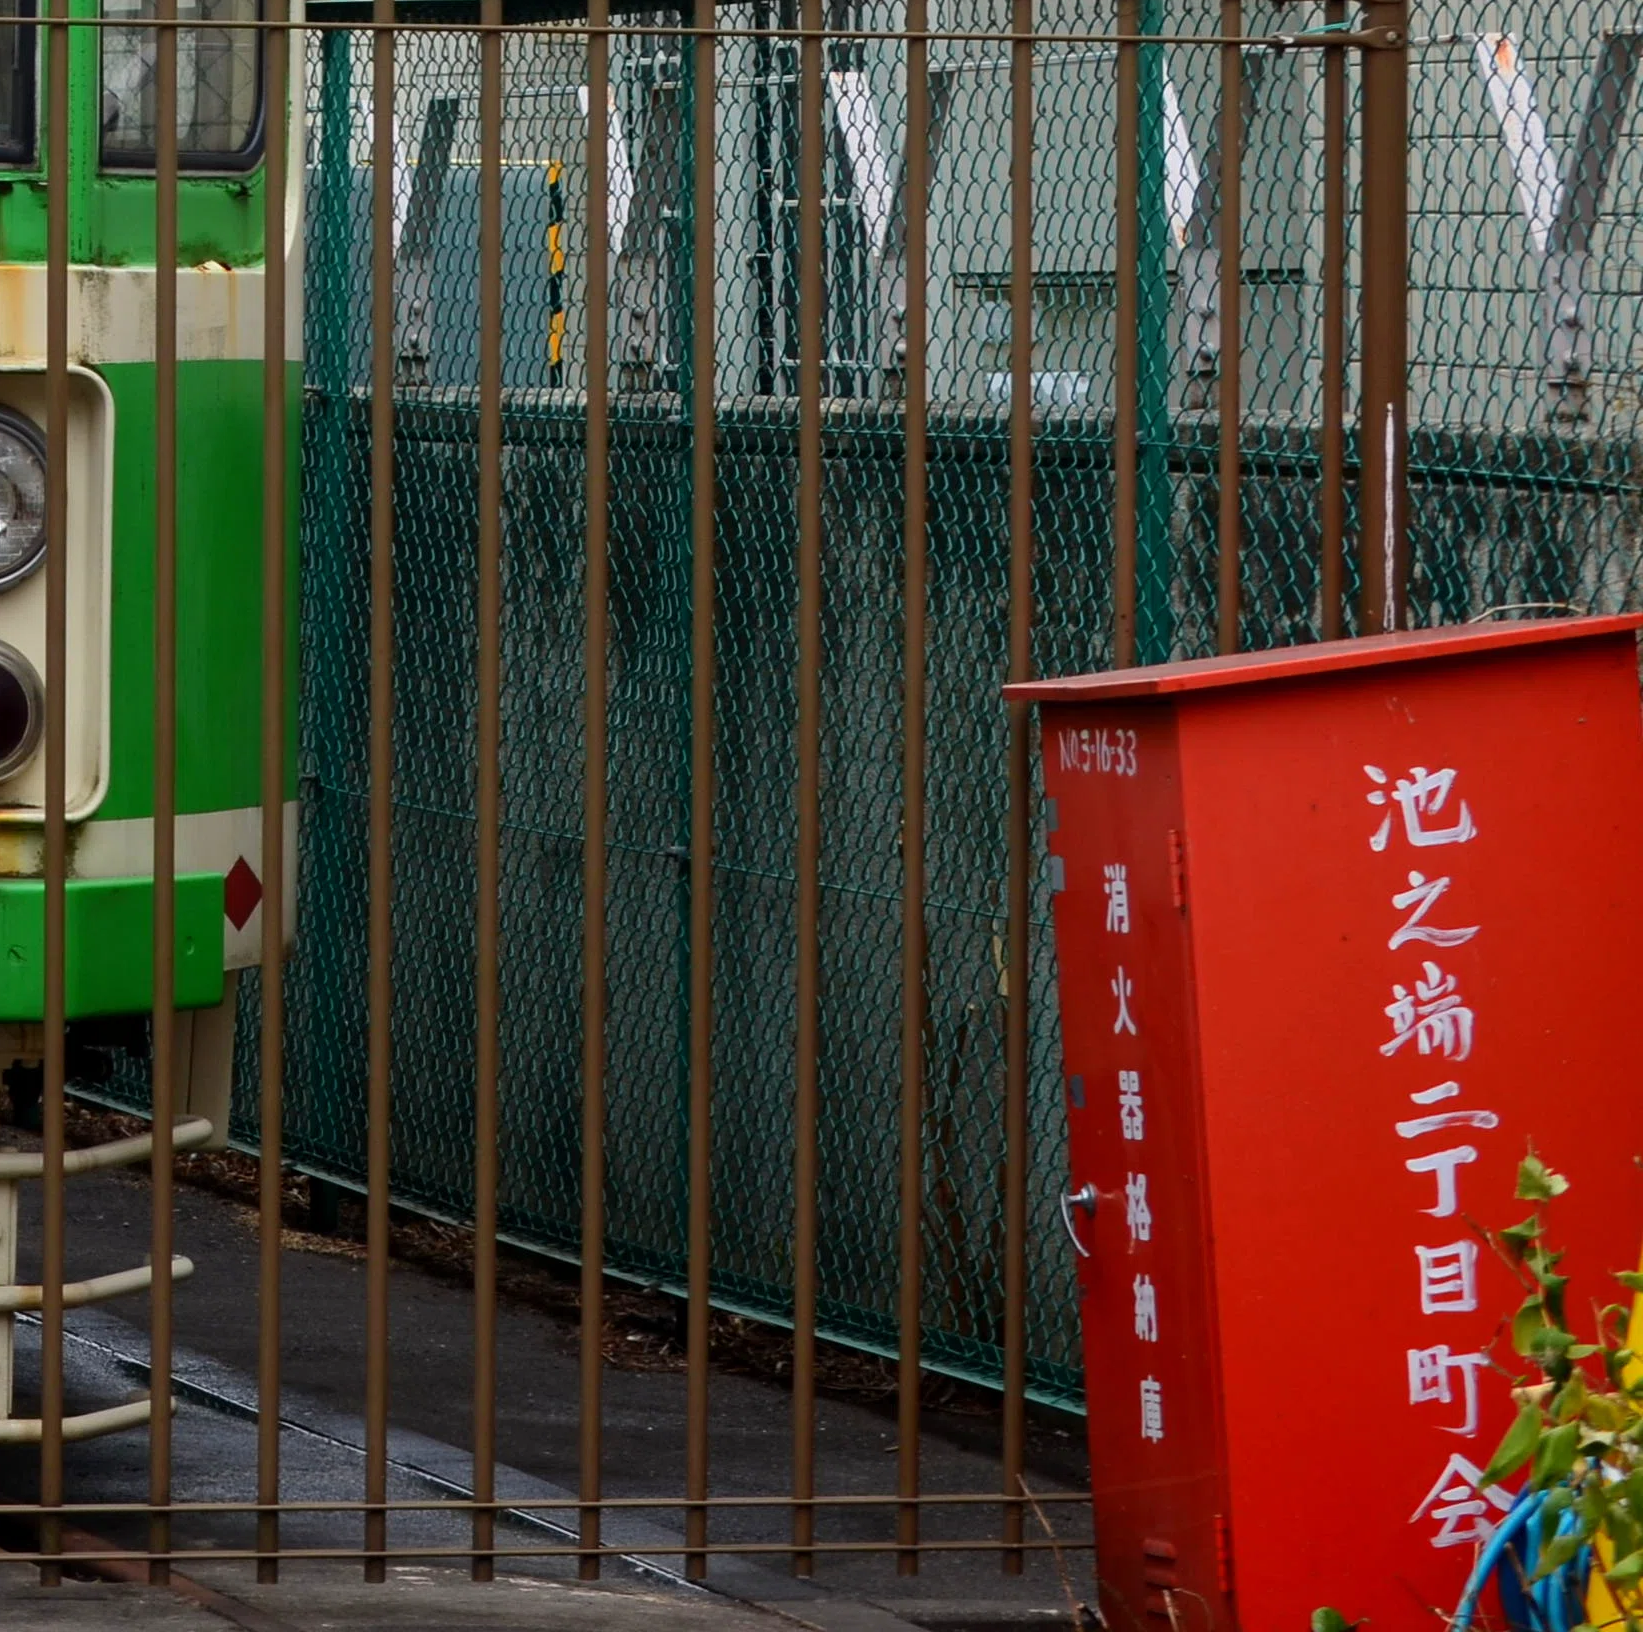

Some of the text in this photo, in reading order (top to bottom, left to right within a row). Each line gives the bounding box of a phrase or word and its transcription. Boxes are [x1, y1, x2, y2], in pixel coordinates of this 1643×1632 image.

[1102, 863, 1164, 1443] 消火器格納庫
[1363, 764, 1515, 1549] 池之端二丁目町会
